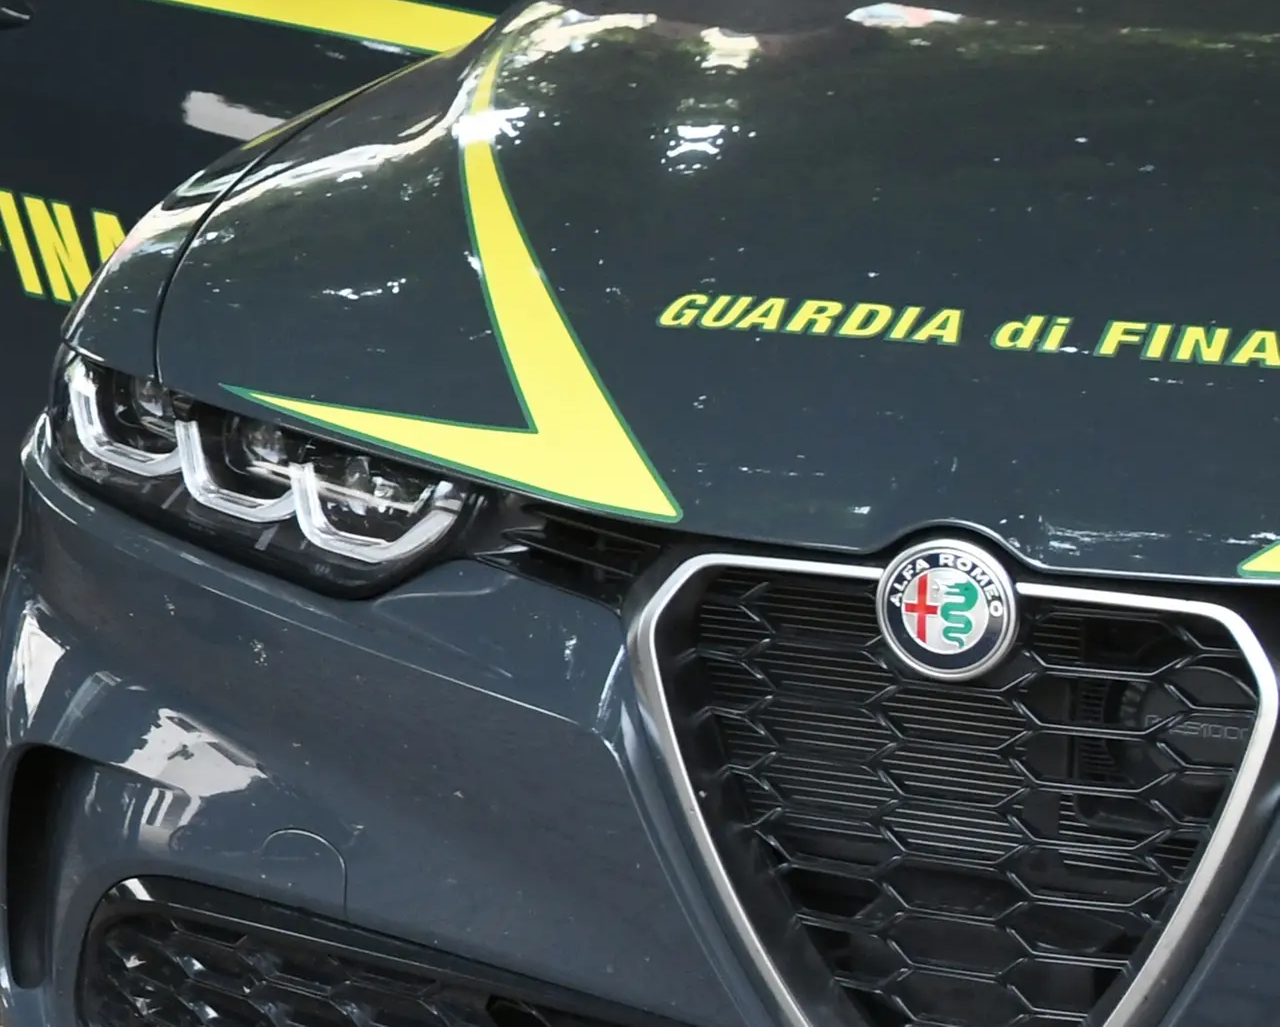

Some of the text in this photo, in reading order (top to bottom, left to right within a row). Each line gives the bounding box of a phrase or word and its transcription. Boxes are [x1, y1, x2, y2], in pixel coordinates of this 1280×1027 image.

[658, 293, 1280, 367] GUARDIA di FINA
[890, 554, 1003, 617] ALFA ROMEO
